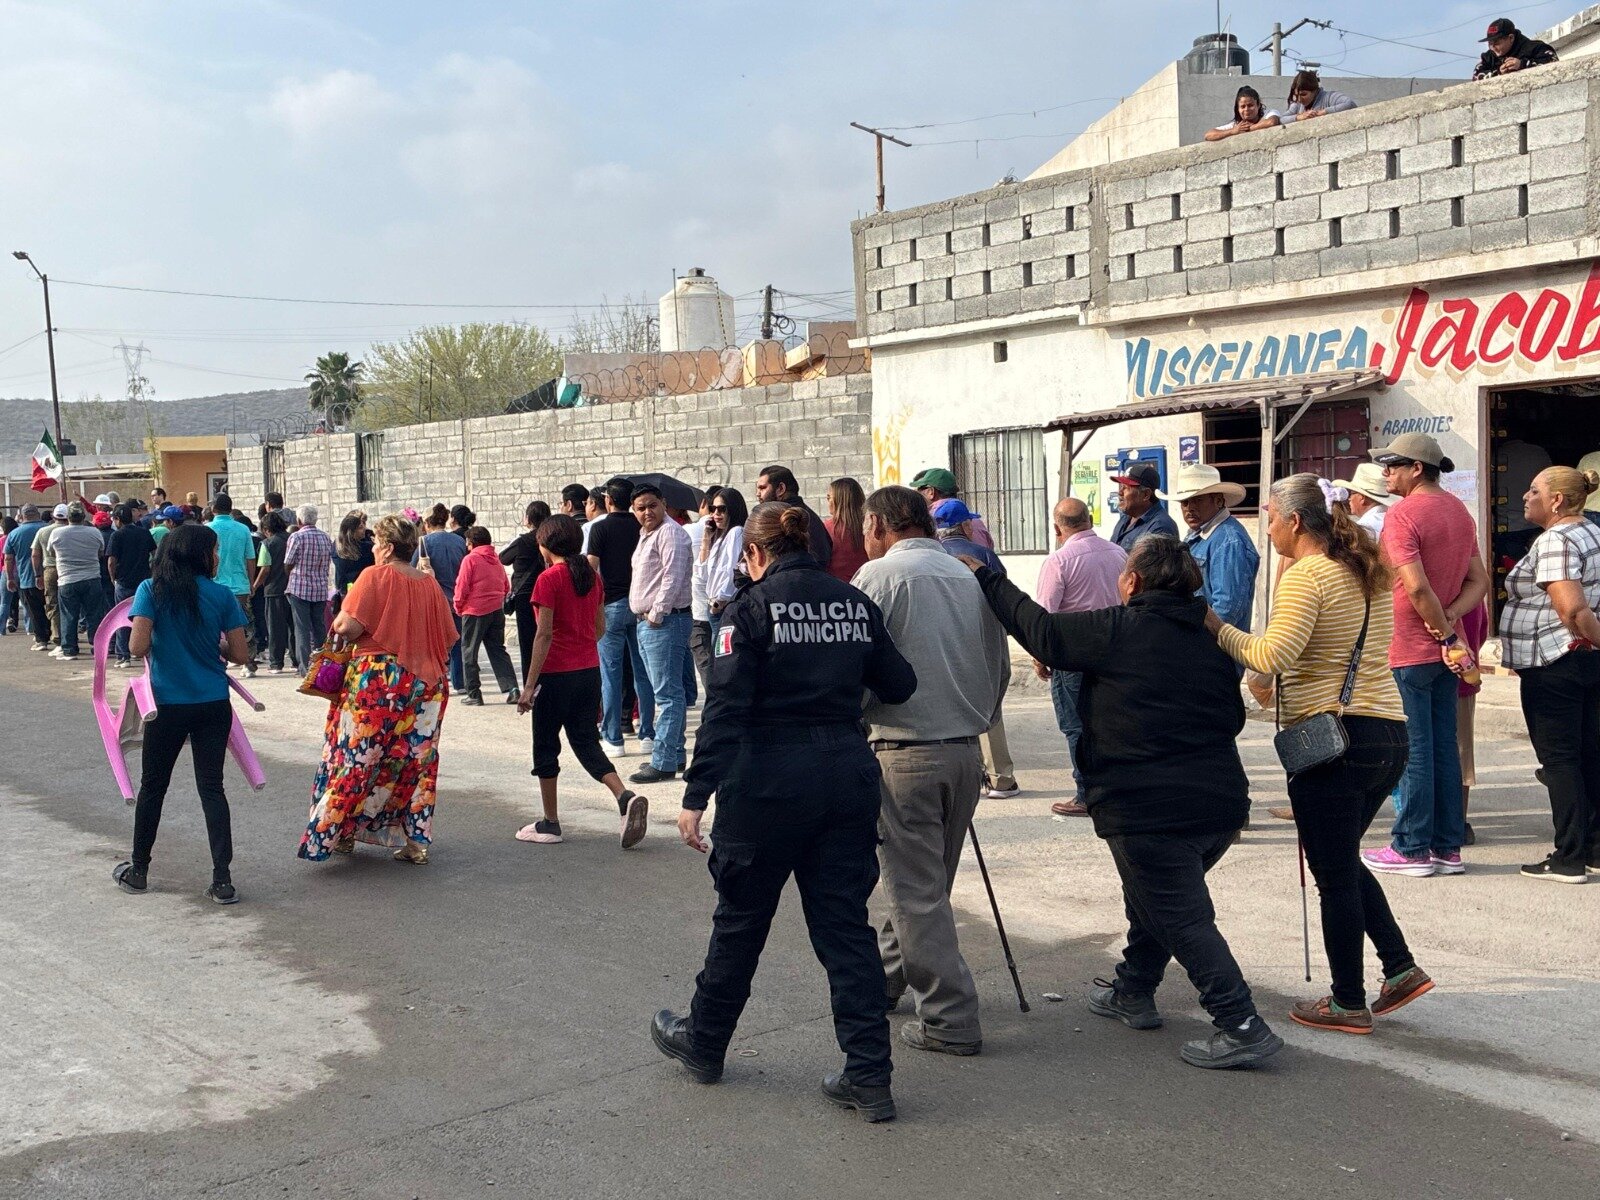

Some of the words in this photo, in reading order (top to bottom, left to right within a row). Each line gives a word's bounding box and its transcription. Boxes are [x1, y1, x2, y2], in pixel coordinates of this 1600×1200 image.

[1125, 326, 1368, 397] MISCELANEA
[1382, 415, 1454, 436] ABARROTES
[769, 598, 870, 621] POLICÍA
[773, 622, 872, 644] MUNICIPAL
